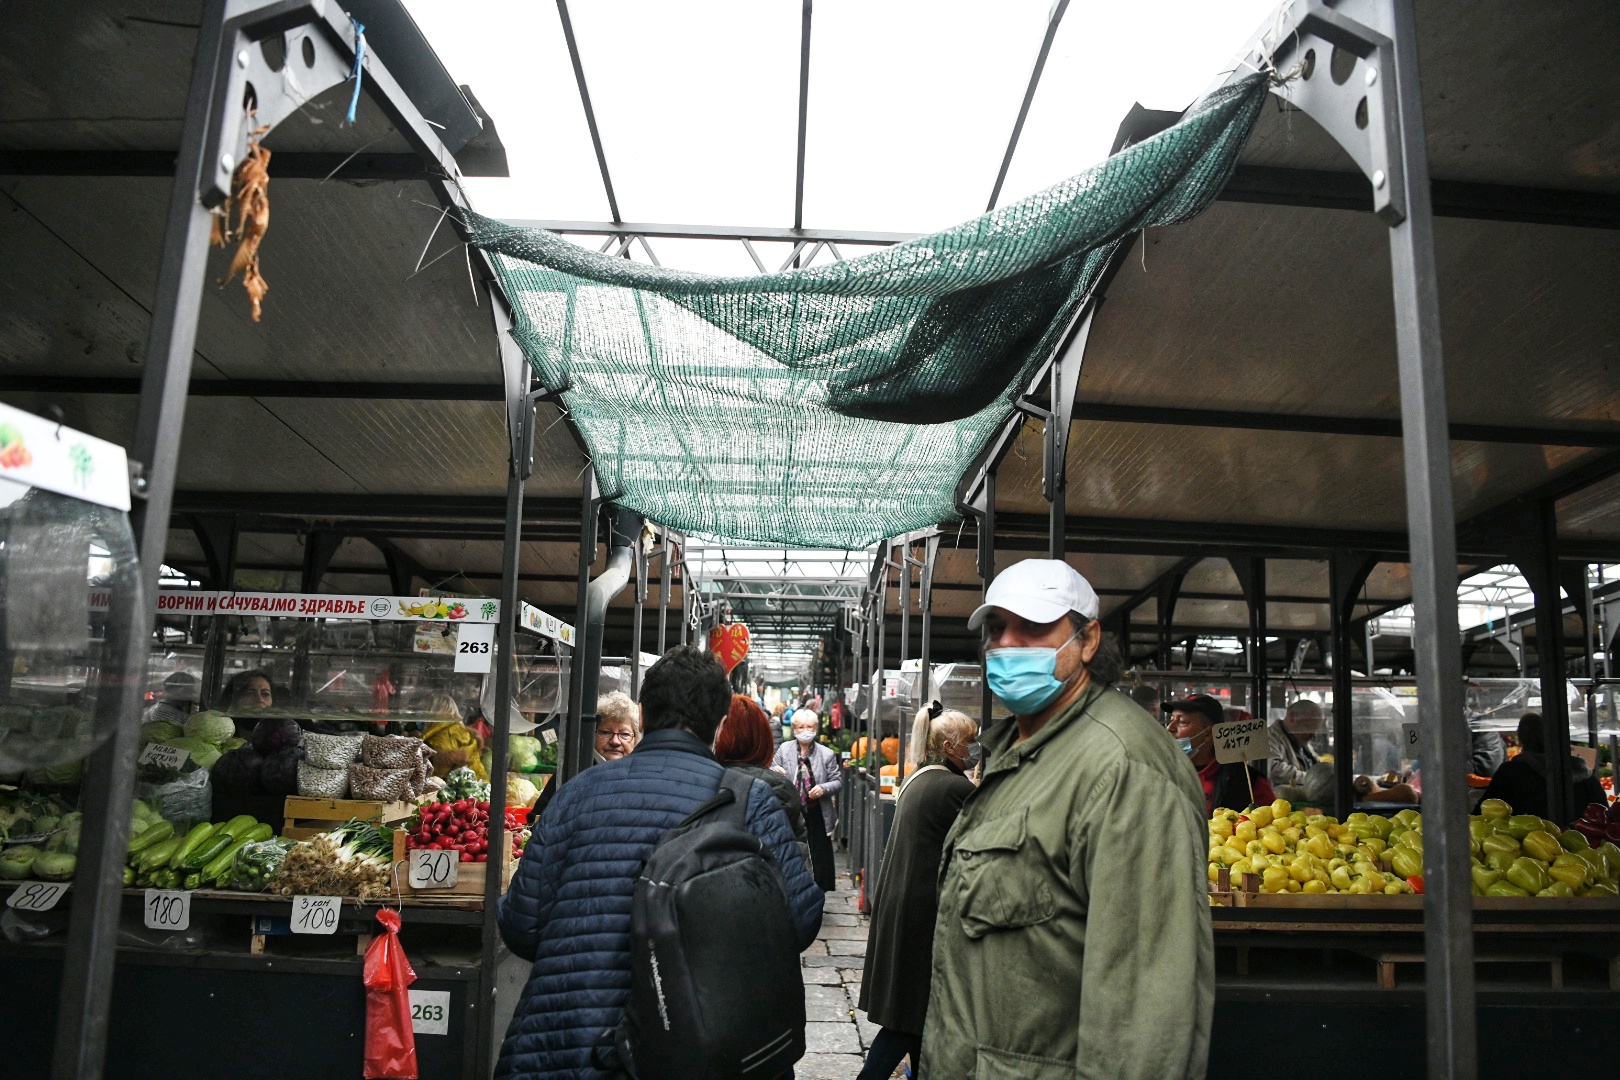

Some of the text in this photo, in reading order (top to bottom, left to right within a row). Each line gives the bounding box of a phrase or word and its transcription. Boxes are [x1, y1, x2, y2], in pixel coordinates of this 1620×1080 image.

[157, 595, 204, 610] ВОРНИ
[218, 596, 297, 612] САЧУВАЈМО
[298, 598, 366, 615] ЗДРАВЉЕ
[459, 641, 490, 654] 263
[1215, 720, 1264, 740] SOMBORKA
[416, 852, 451, 883] 30
[13, 883, 60, 909] 80
[300, 897, 310, 910] 3
[149, 894, 184, 925] 180
[298, 906, 336, 930] 100
[411, 1004, 444, 1021] 263
